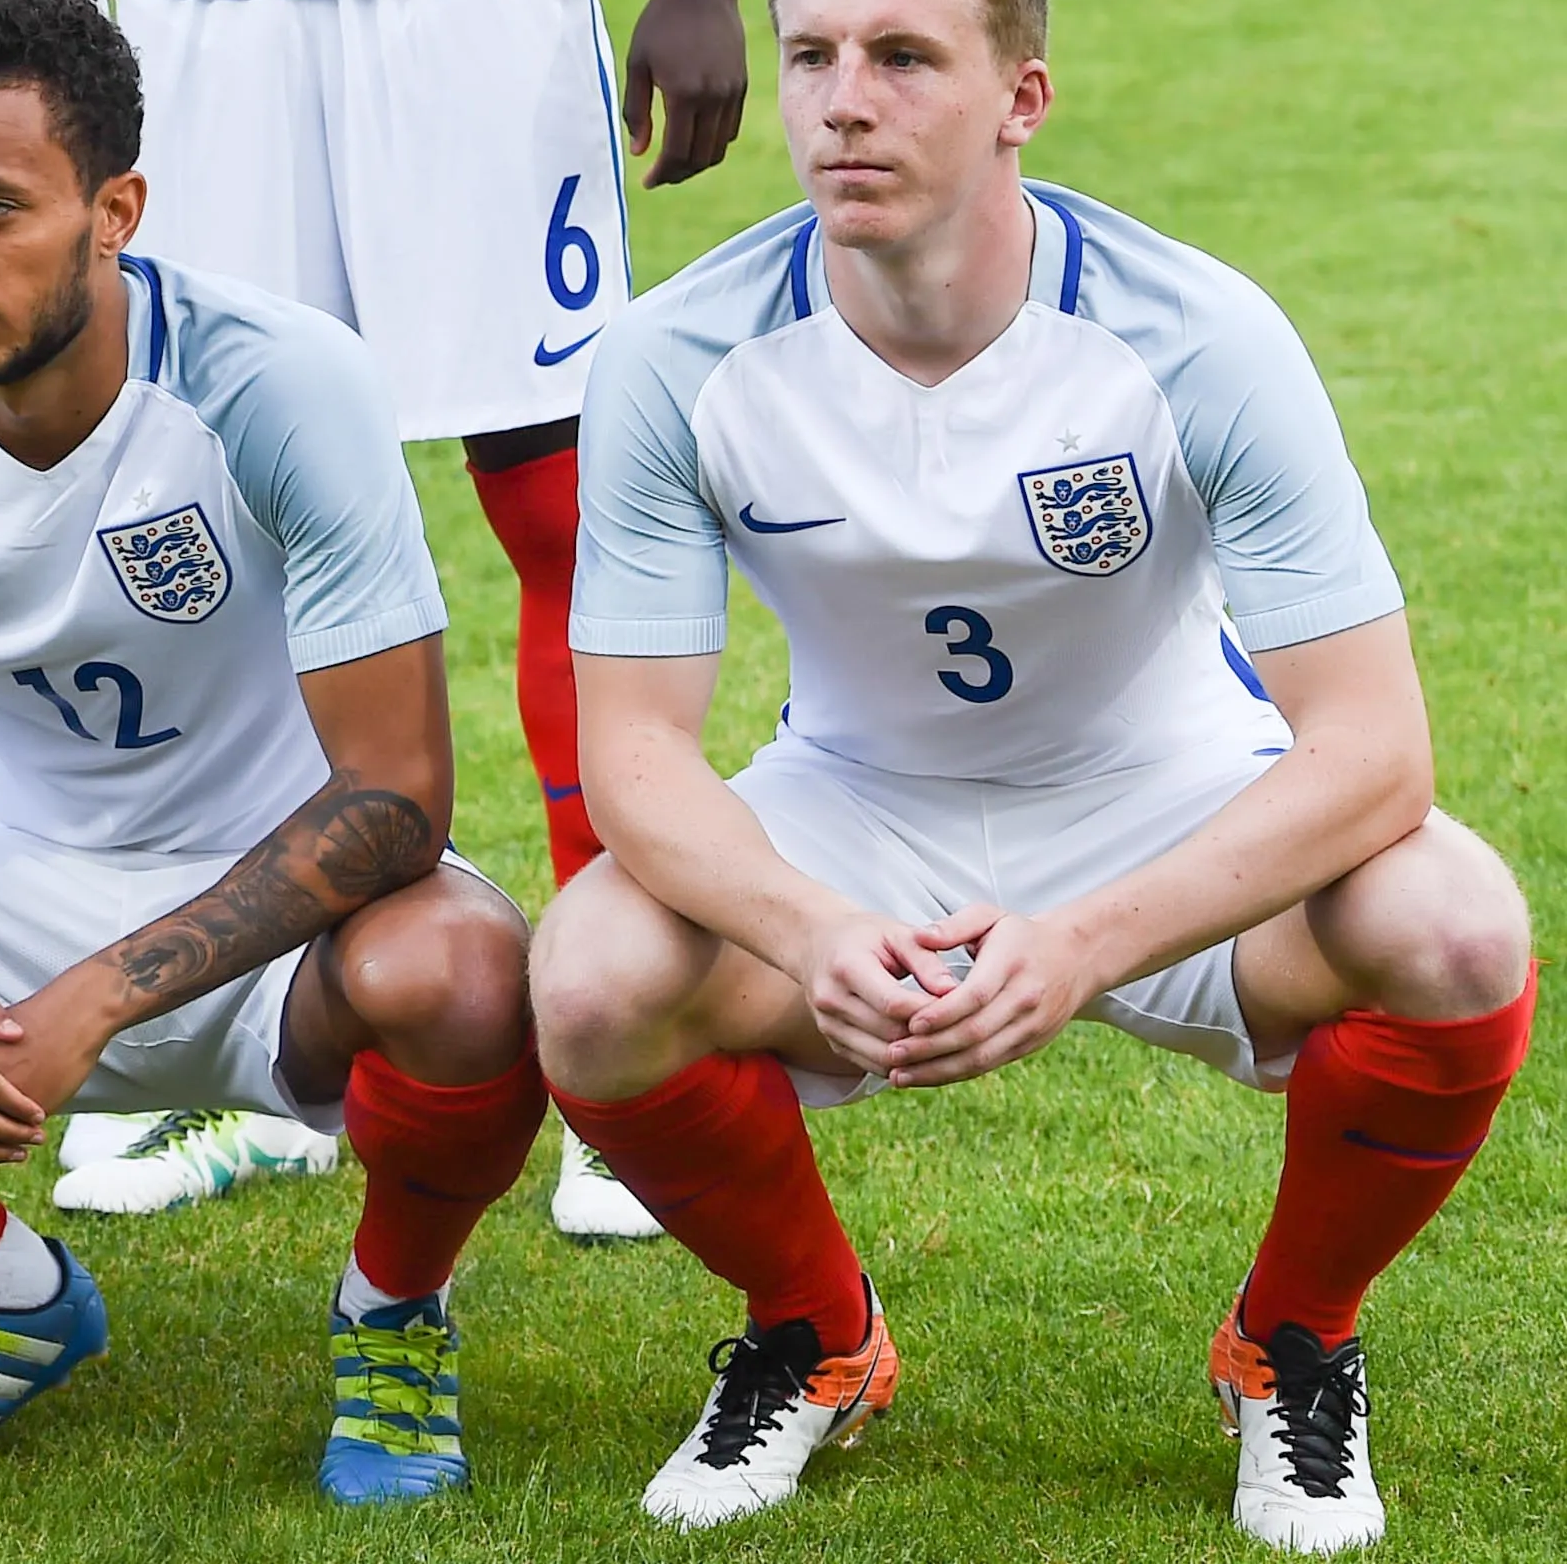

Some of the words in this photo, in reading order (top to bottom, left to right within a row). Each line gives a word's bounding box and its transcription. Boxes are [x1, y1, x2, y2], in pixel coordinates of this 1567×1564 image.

[543, 173, 601, 312] 6
[11, 660, 183, 750] 12
[924, 604, 1014, 705] 3
